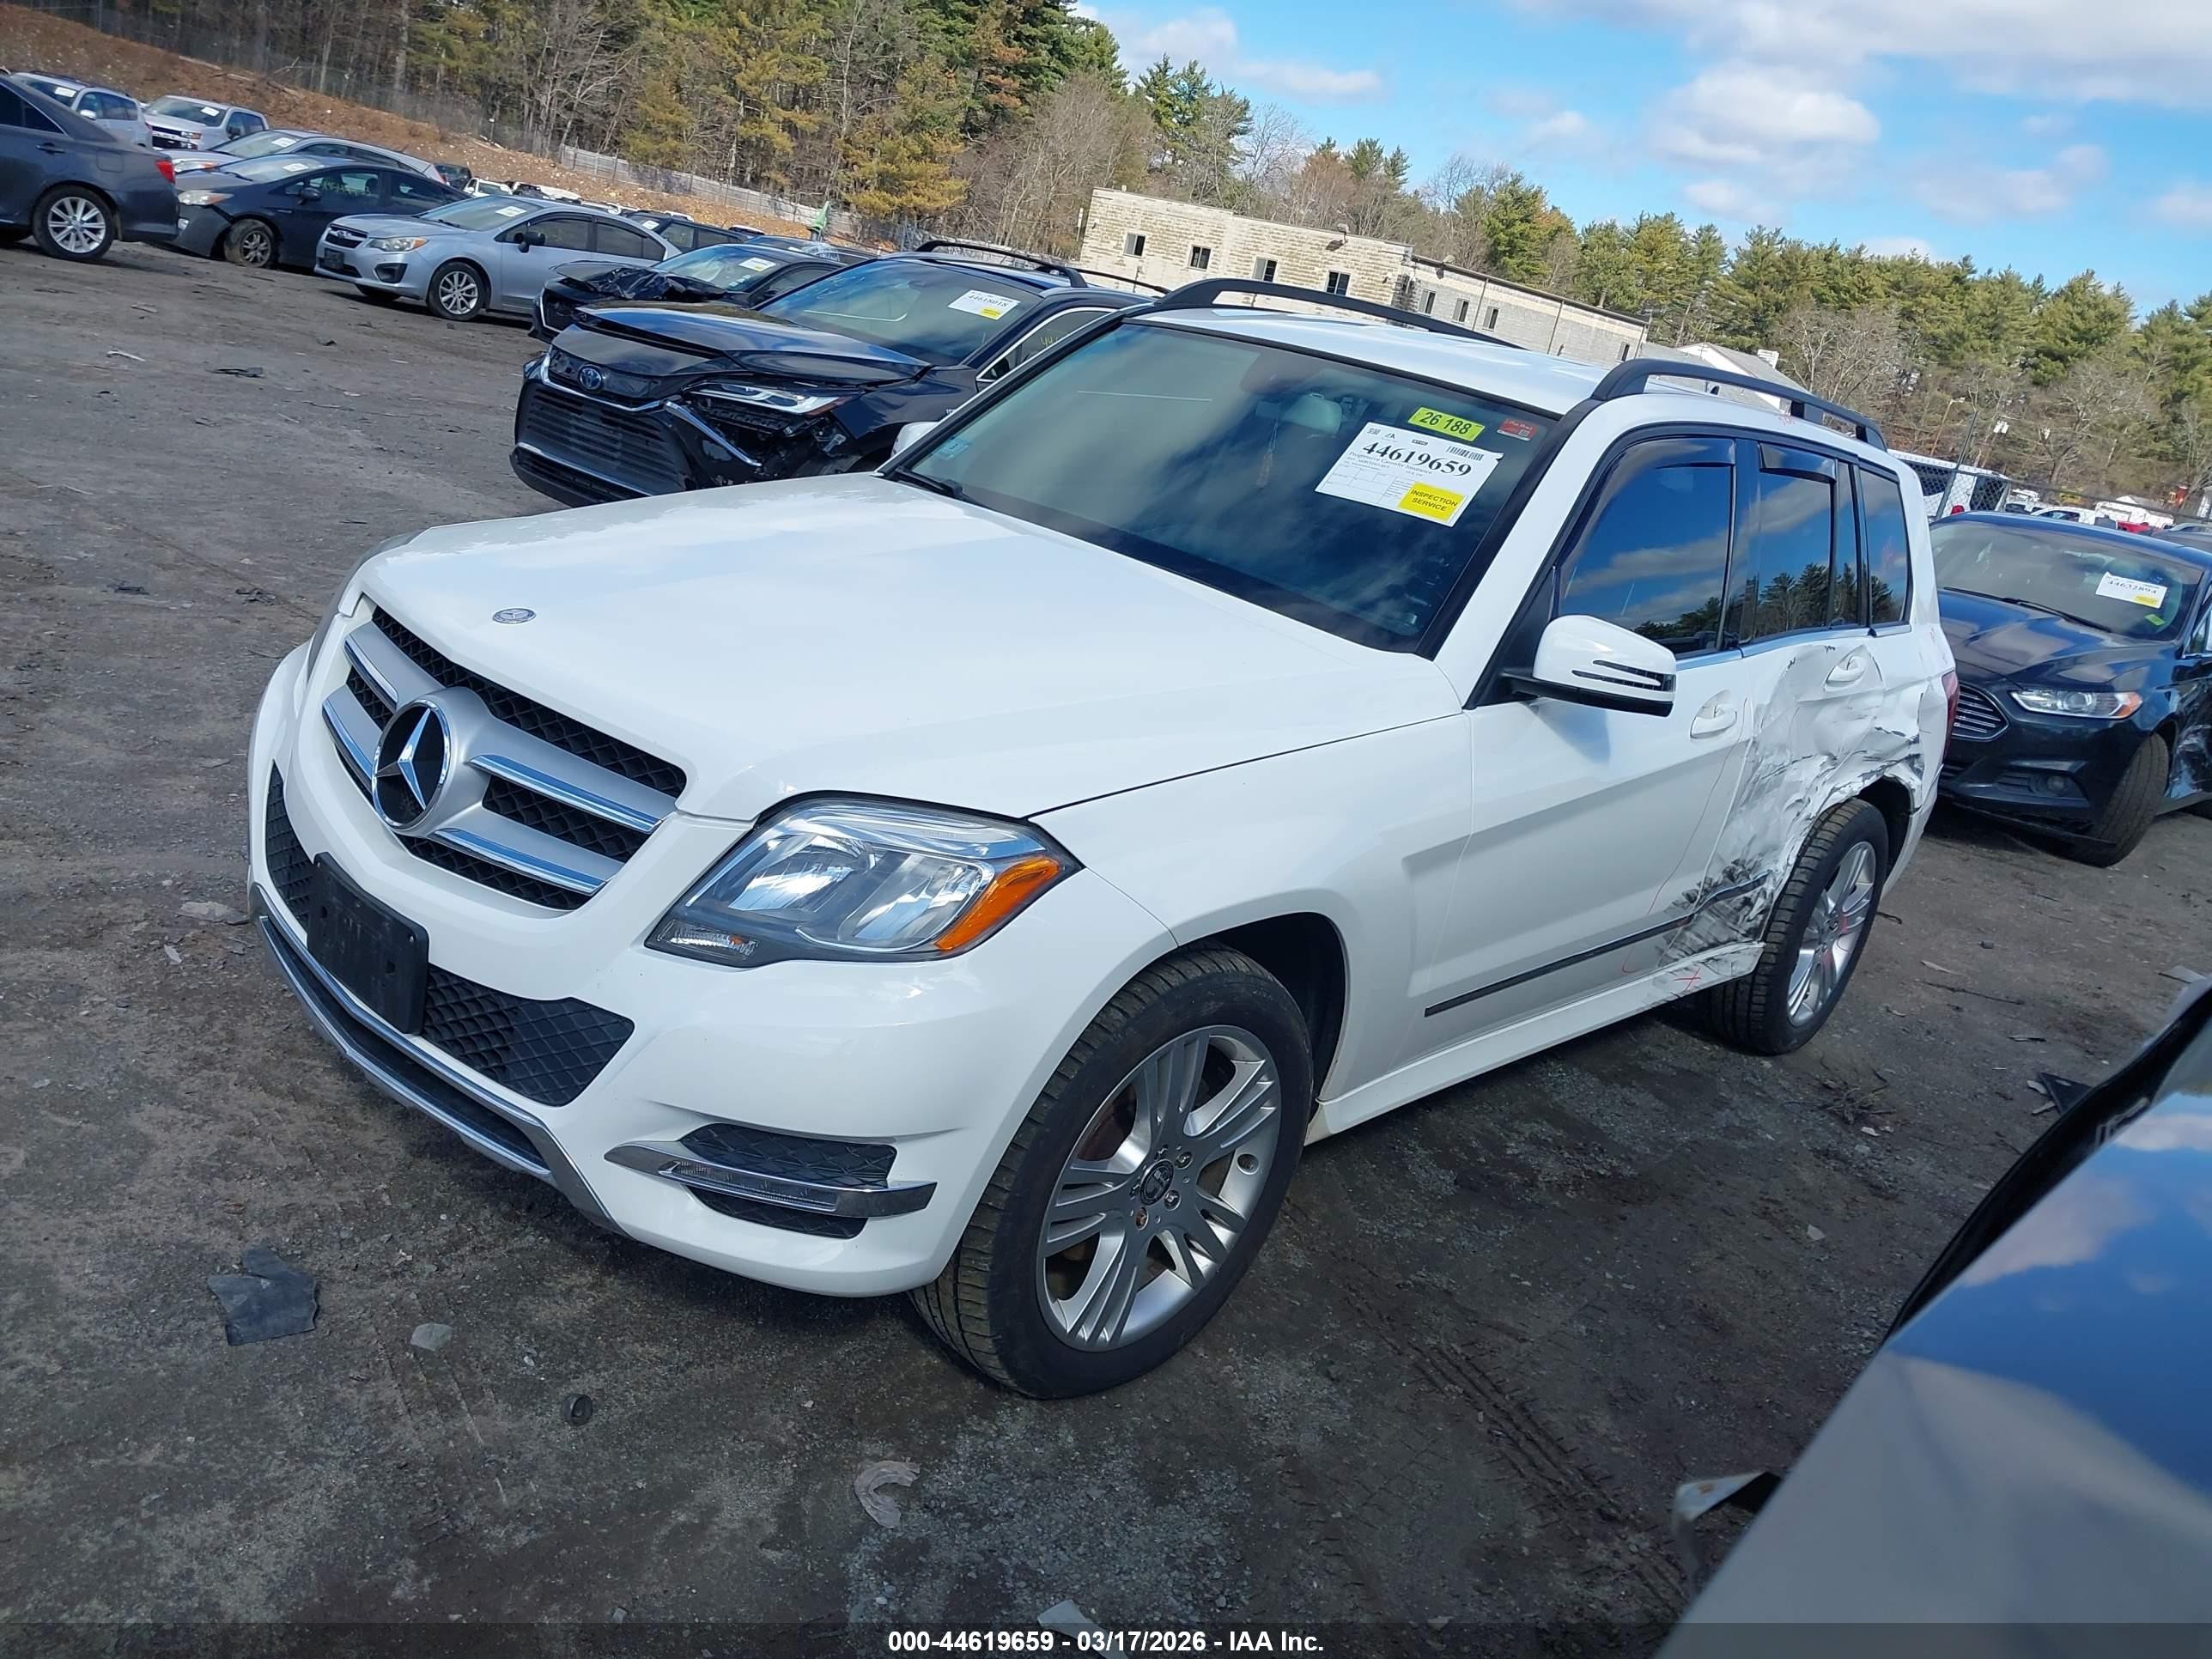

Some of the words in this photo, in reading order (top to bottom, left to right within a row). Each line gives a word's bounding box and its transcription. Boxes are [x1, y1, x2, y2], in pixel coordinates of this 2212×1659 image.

[1419, 411, 1443, 426] 26
[1443, 417, 1473, 435] 188
[1362, 441, 1473, 477] 44619659
[1411, 489, 1459, 508] INSPECTION
[1412, 497, 1448, 512] SERVICE
